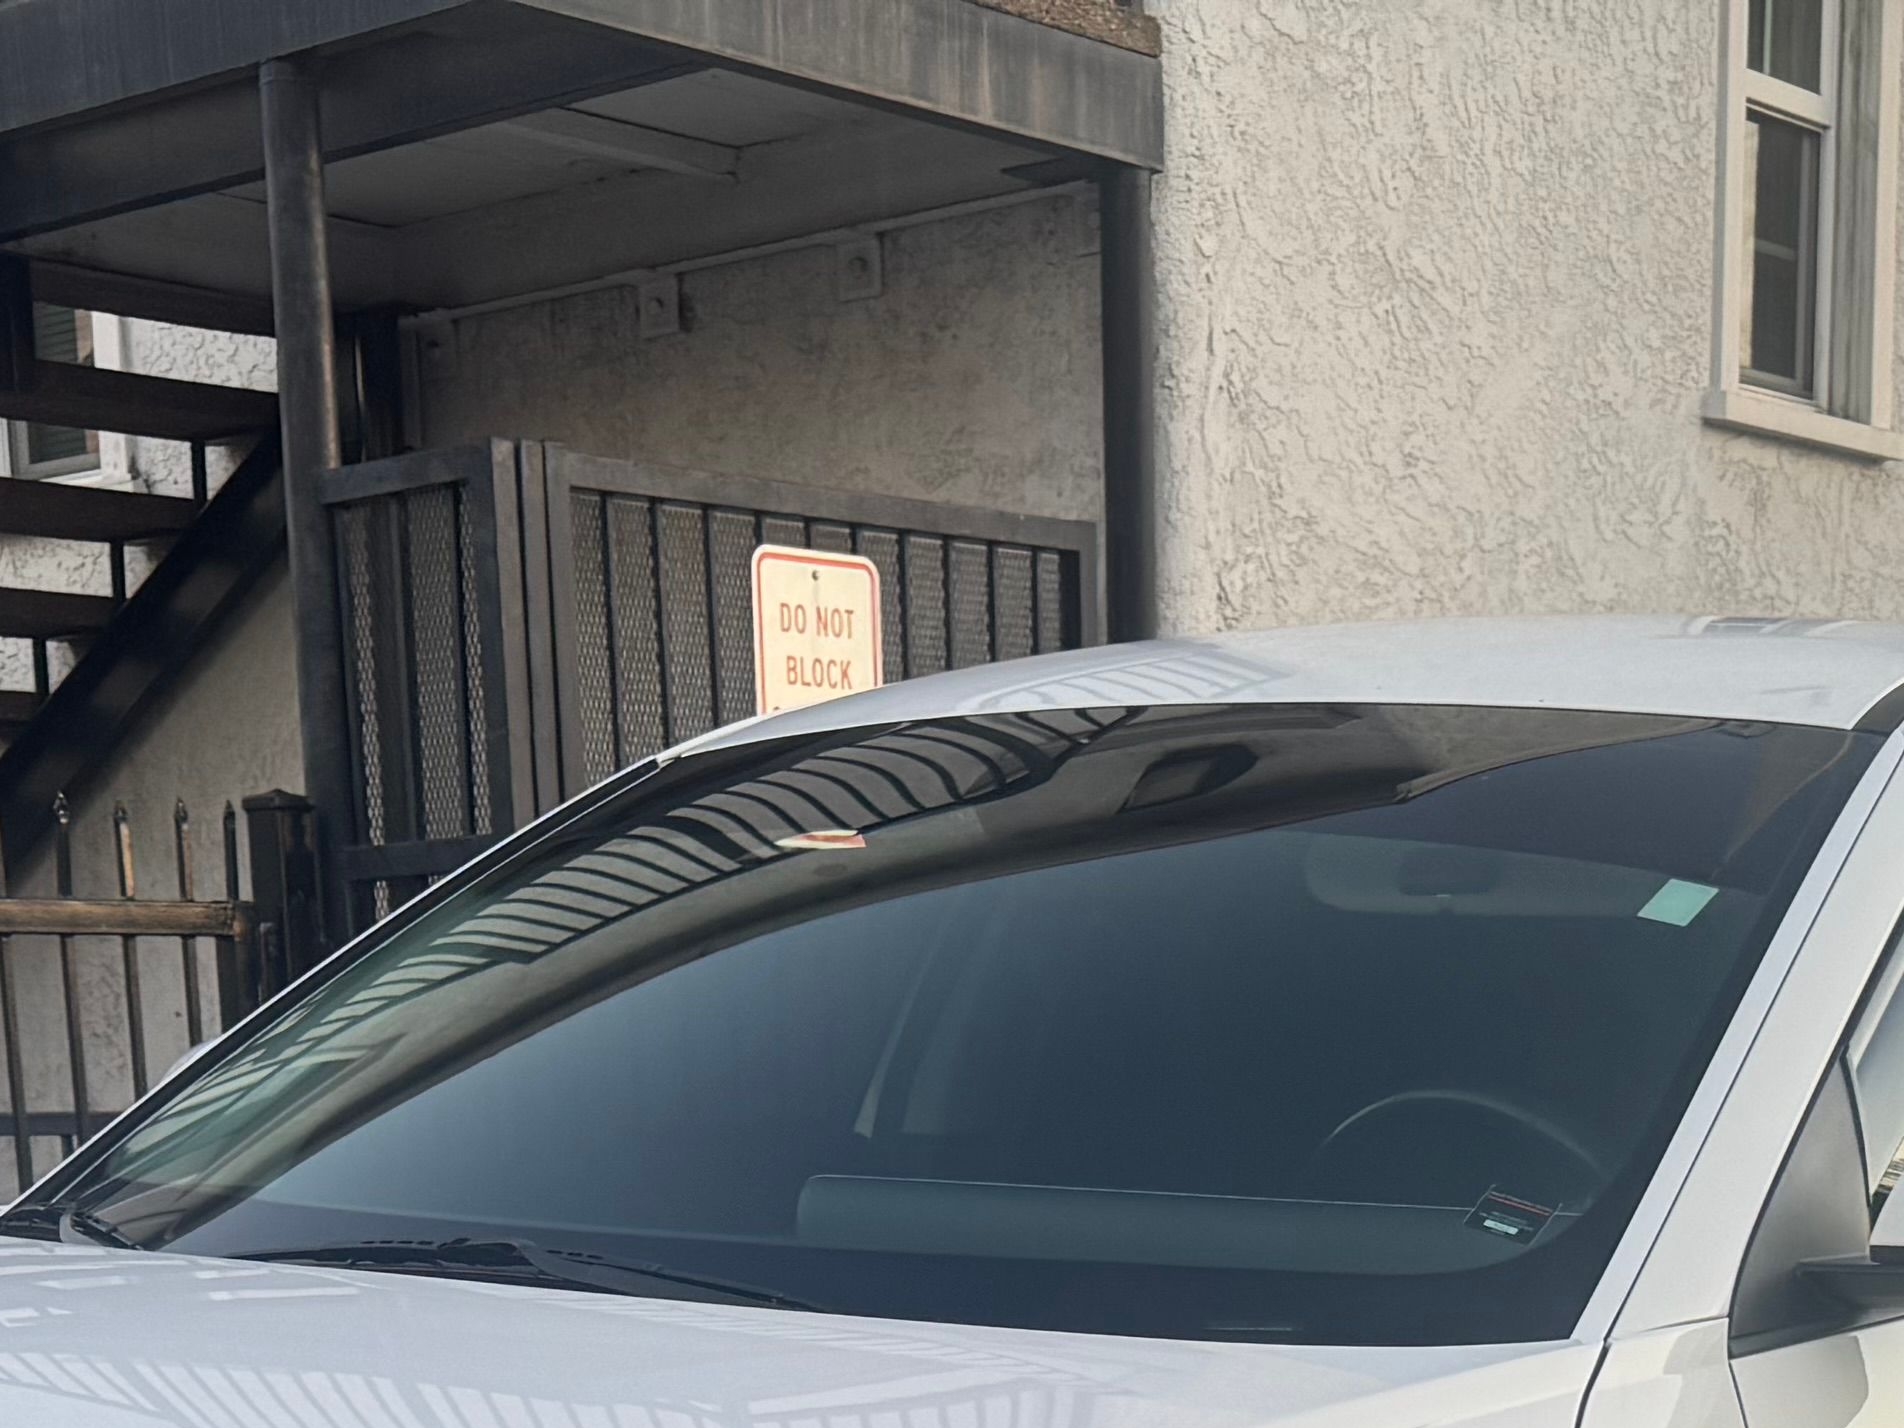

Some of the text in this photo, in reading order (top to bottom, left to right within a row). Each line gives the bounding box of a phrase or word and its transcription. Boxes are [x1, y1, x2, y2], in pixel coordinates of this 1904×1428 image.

[779, 602, 855, 640] DO NOT
[786, 655, 853, 690] BLOCK
